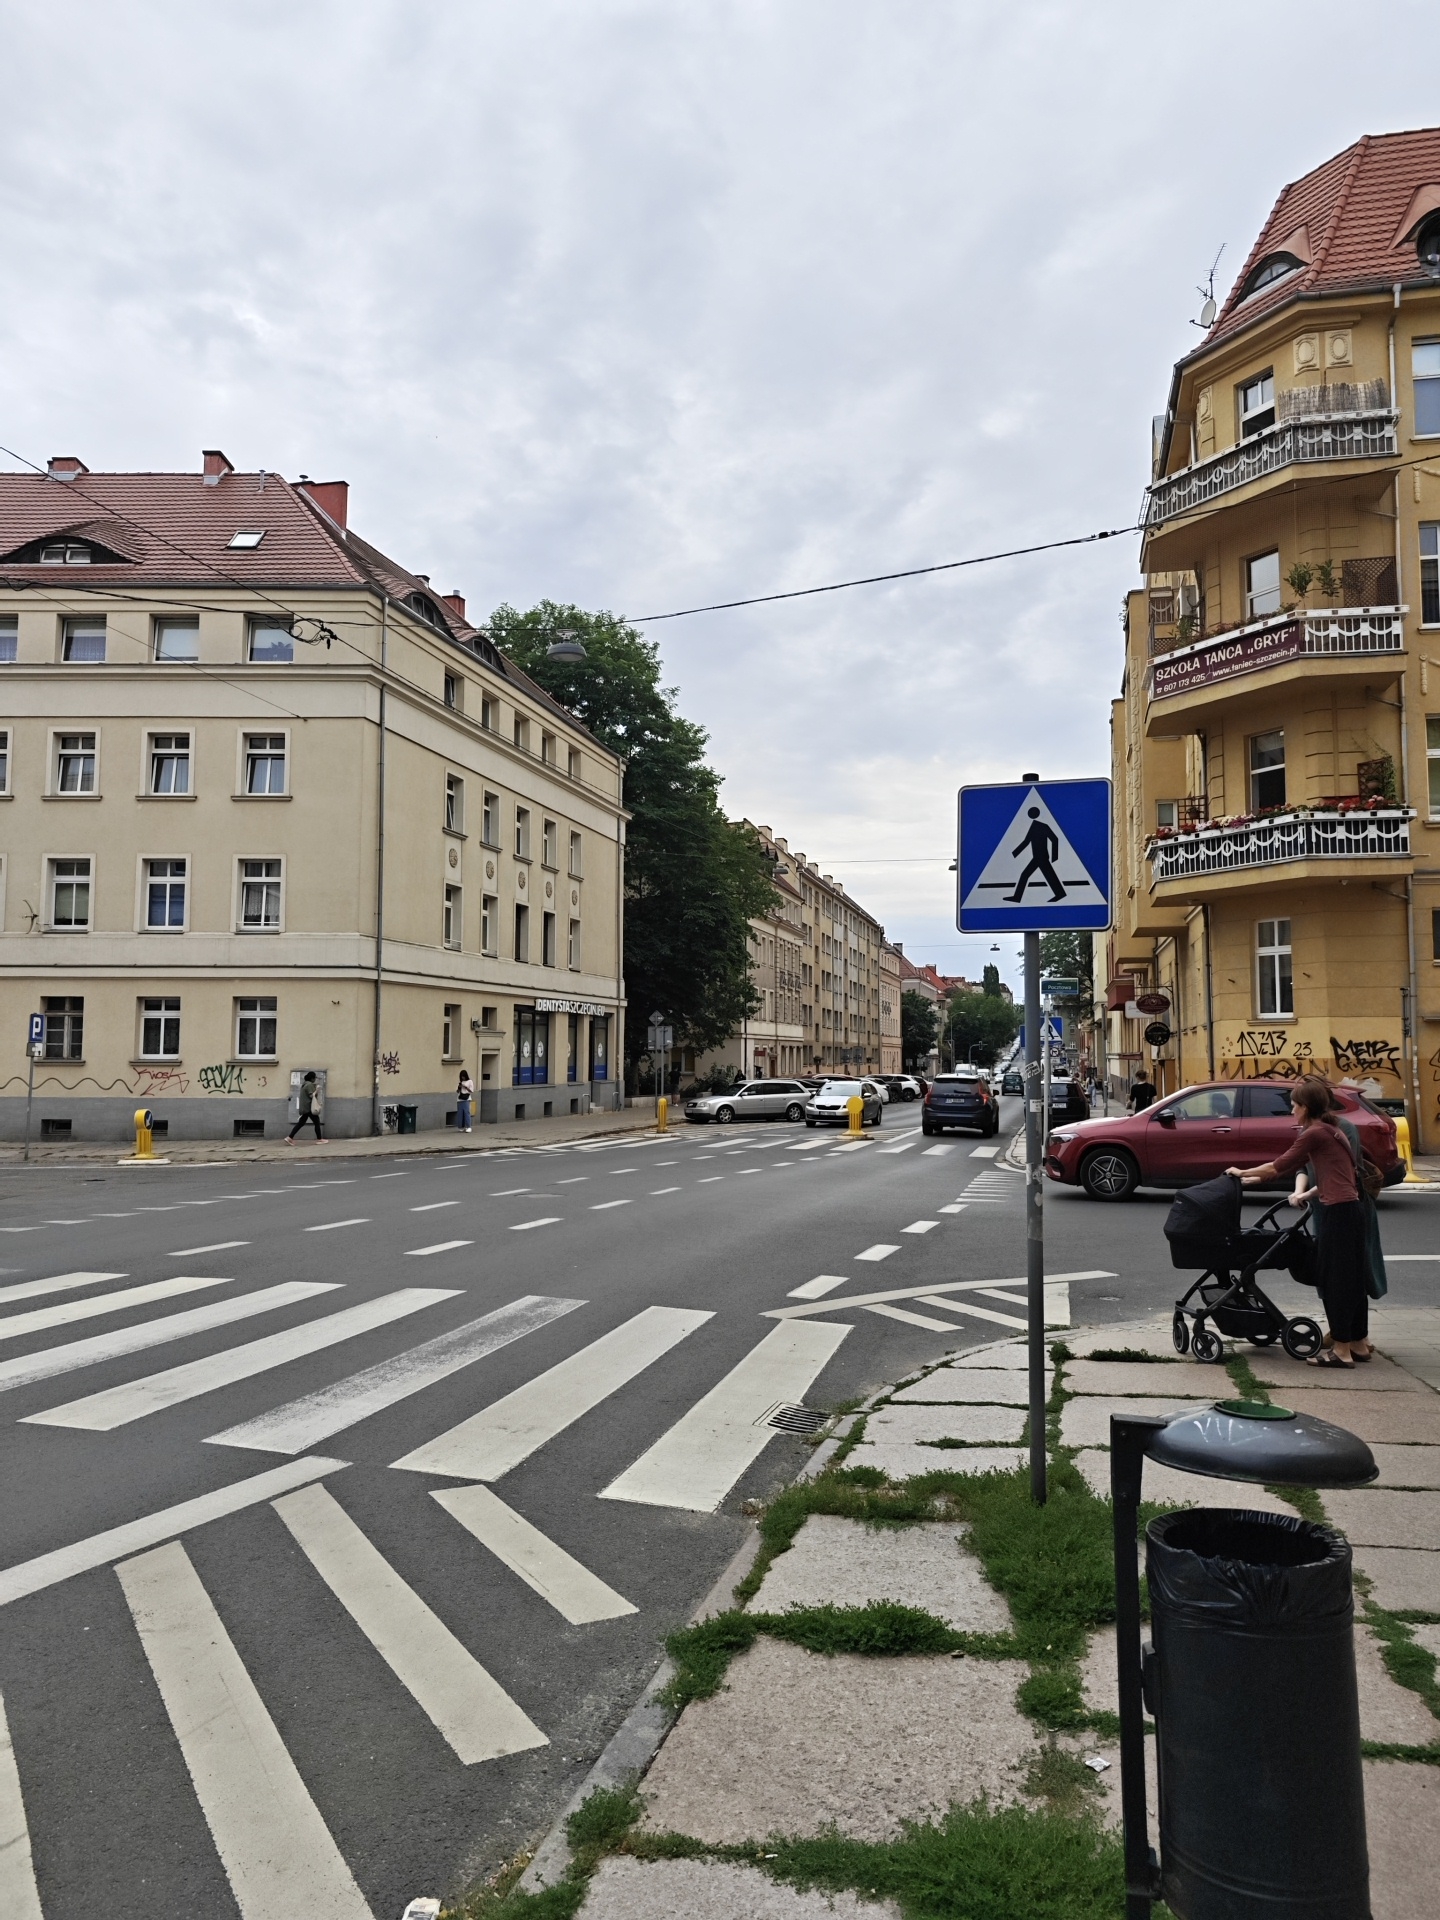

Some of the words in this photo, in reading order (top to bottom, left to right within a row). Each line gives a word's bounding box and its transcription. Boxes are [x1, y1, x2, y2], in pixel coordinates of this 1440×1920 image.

[1156, 657, 1200, 681] SZKOŁA
[1204, 644, 1243, 666] TAŃCA
[1163, 682, 1177, 693] 607
[1178, 678, 1189, 688] 173
[1191, 673, 1206, 684] 425
[1212, 645, 1297, 677] www.taniec-szczecin.pl
[32, 1017, 42, 1039] P
